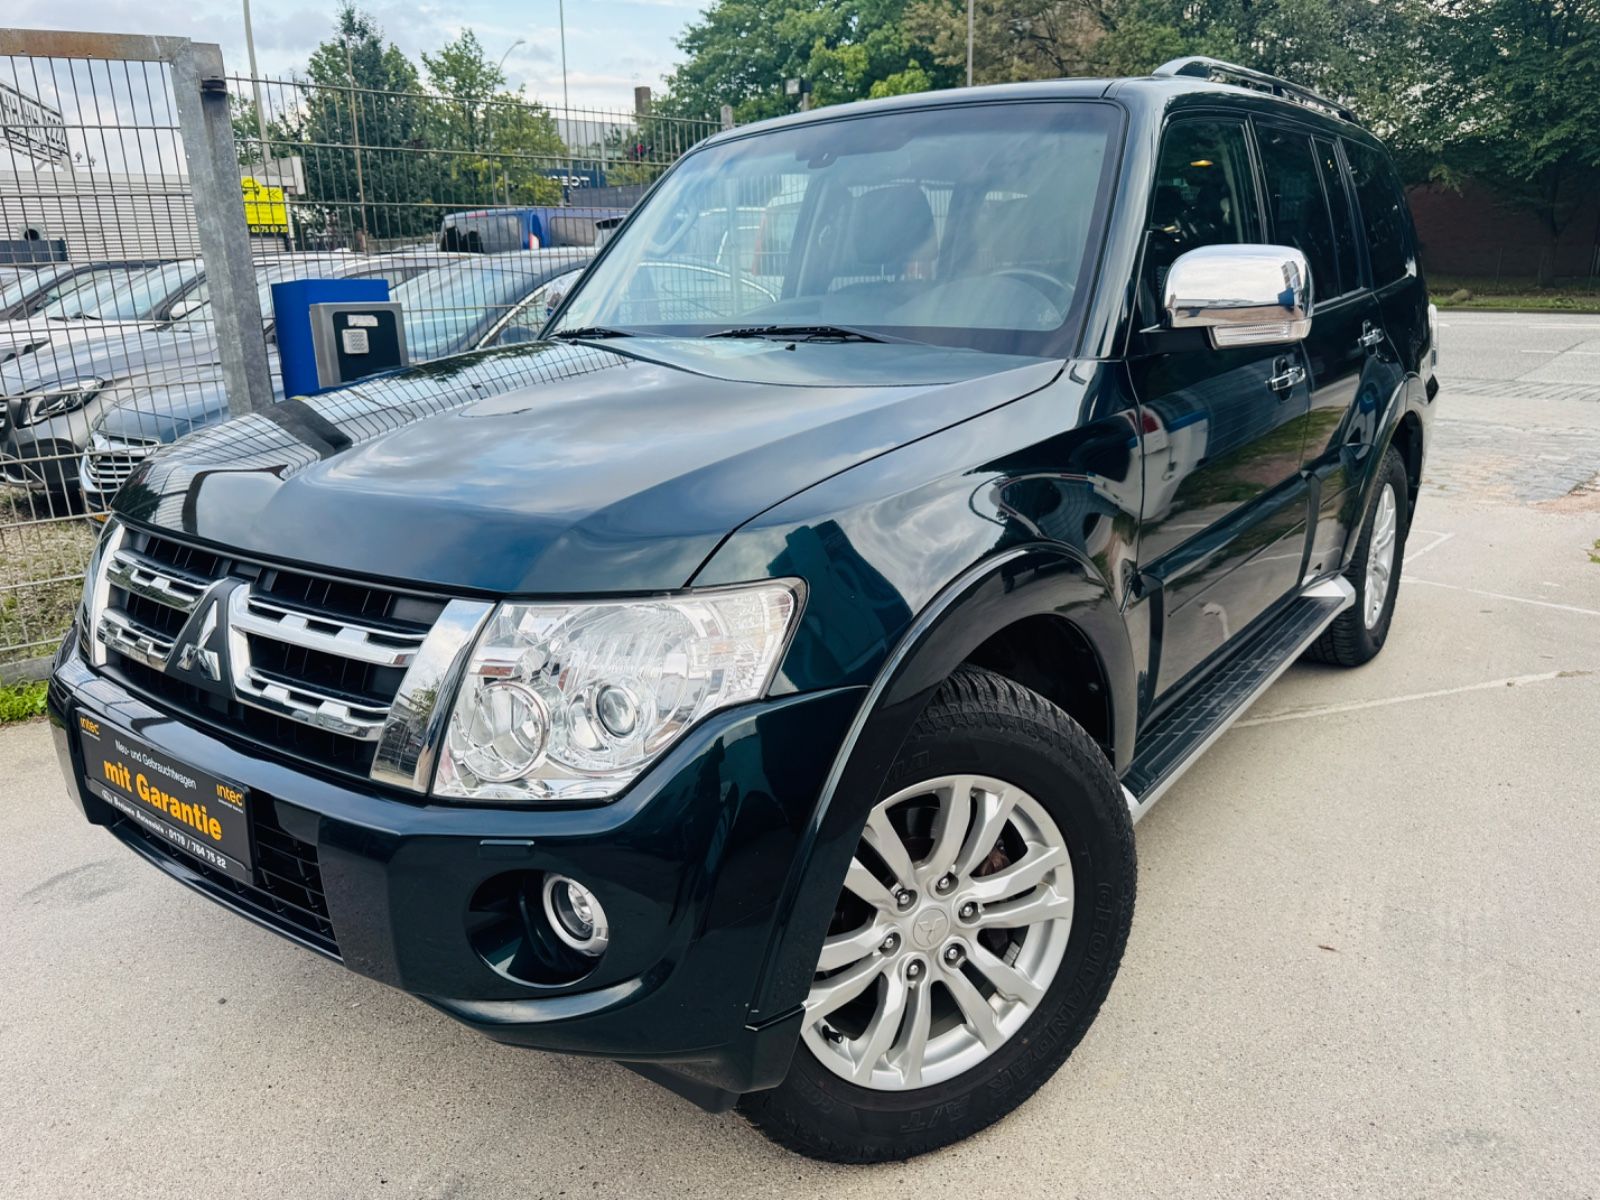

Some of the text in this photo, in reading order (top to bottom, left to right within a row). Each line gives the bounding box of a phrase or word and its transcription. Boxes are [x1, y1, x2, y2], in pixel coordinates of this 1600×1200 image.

[130, 749, 142, 763] und
[142, 753, 197, 790] Gebrauchtwagen
[103, 760, 133, 793] mit
[136, 773, 222, 841] Garantie
[216, 783, 243, 807] intec
